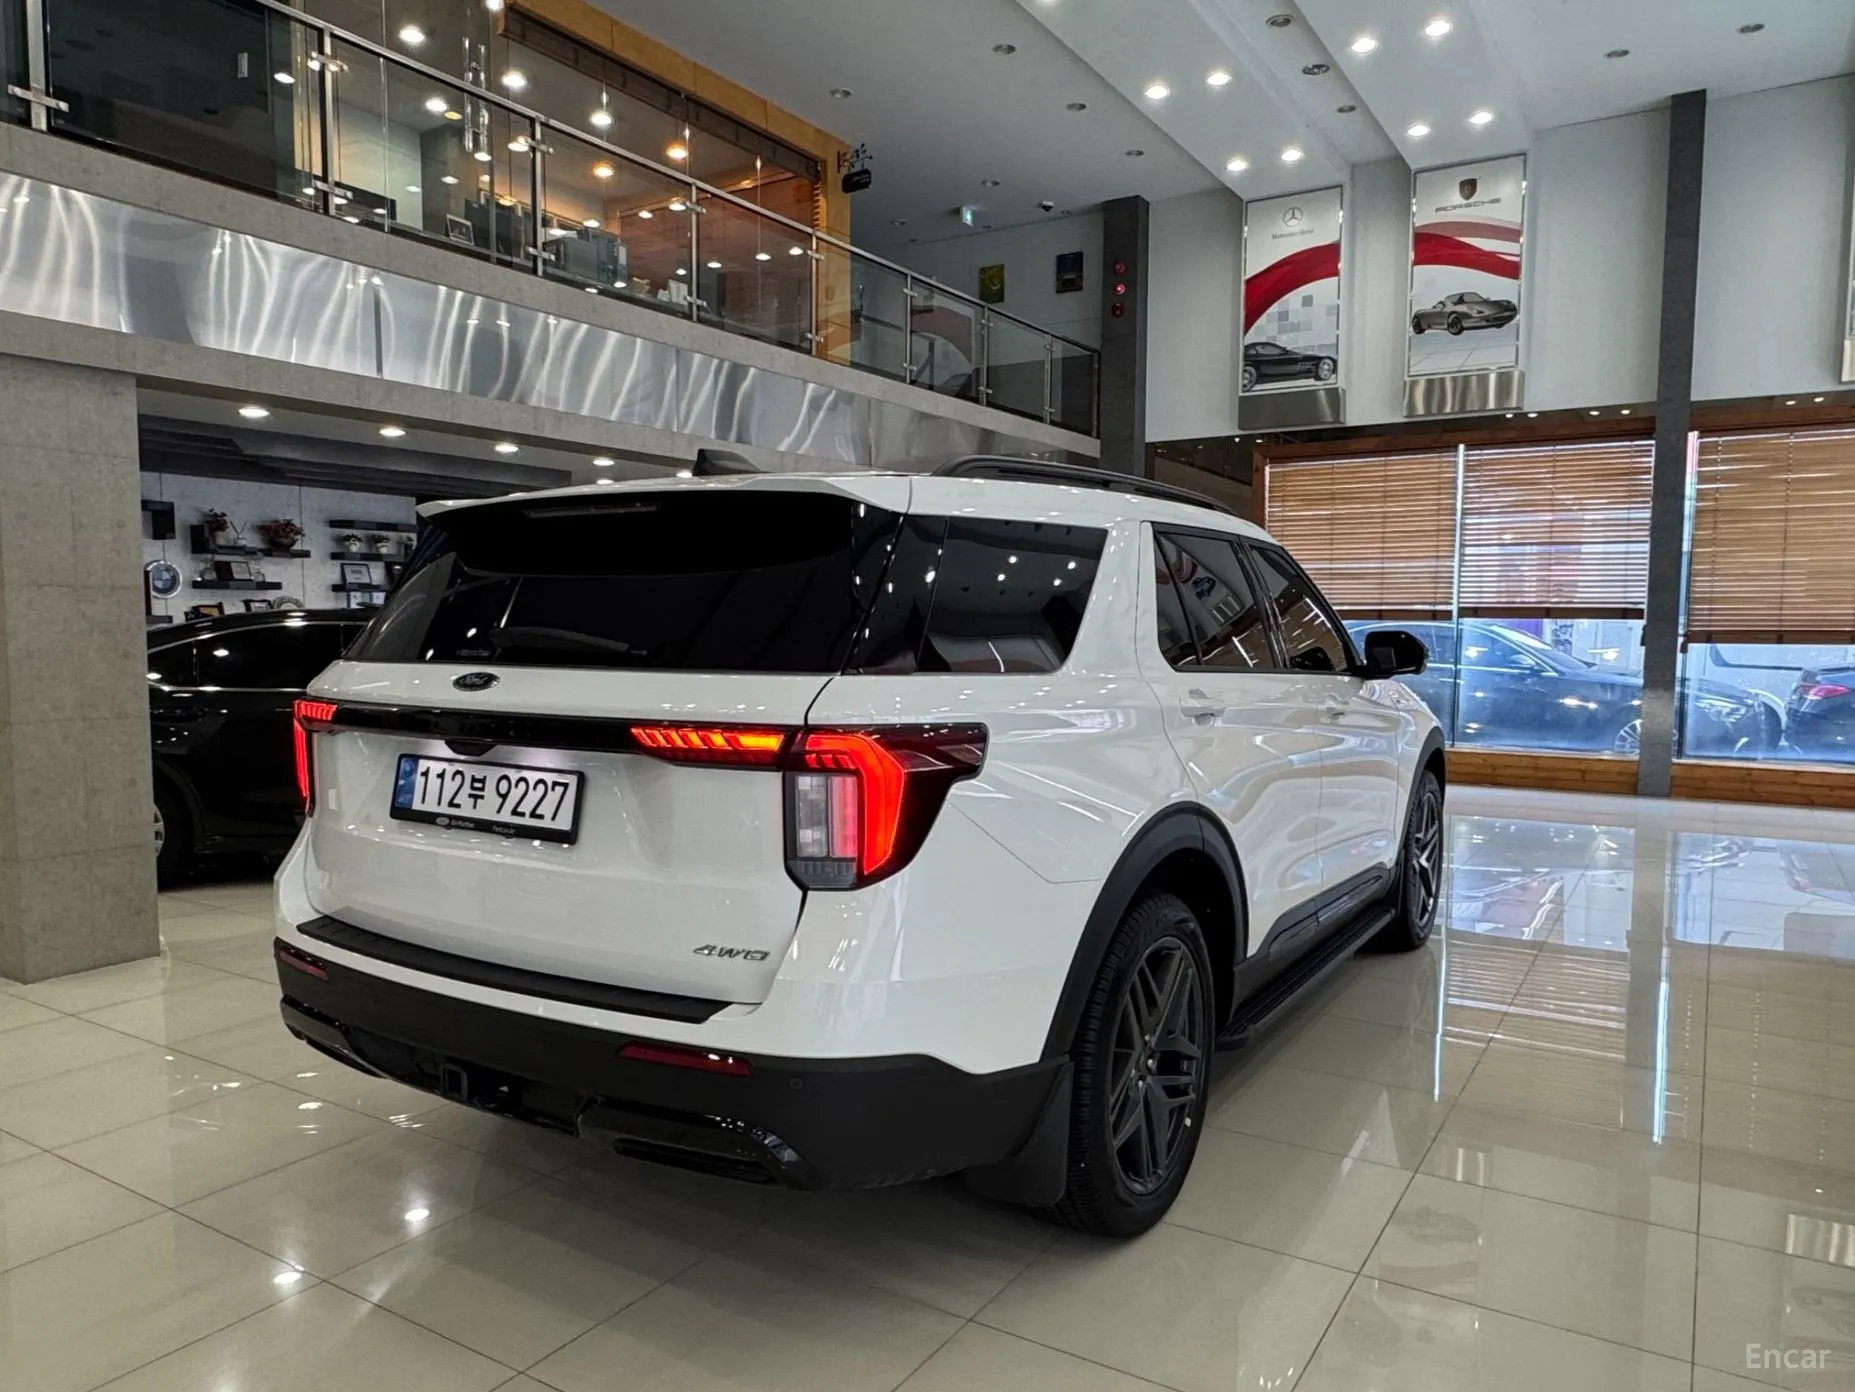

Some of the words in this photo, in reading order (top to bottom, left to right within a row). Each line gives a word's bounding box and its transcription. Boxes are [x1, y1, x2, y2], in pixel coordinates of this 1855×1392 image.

[420, 766, 487, 810] 112부
[495, 774, 570, 822] 9227
[693, 944, 770, 961] 4WD
